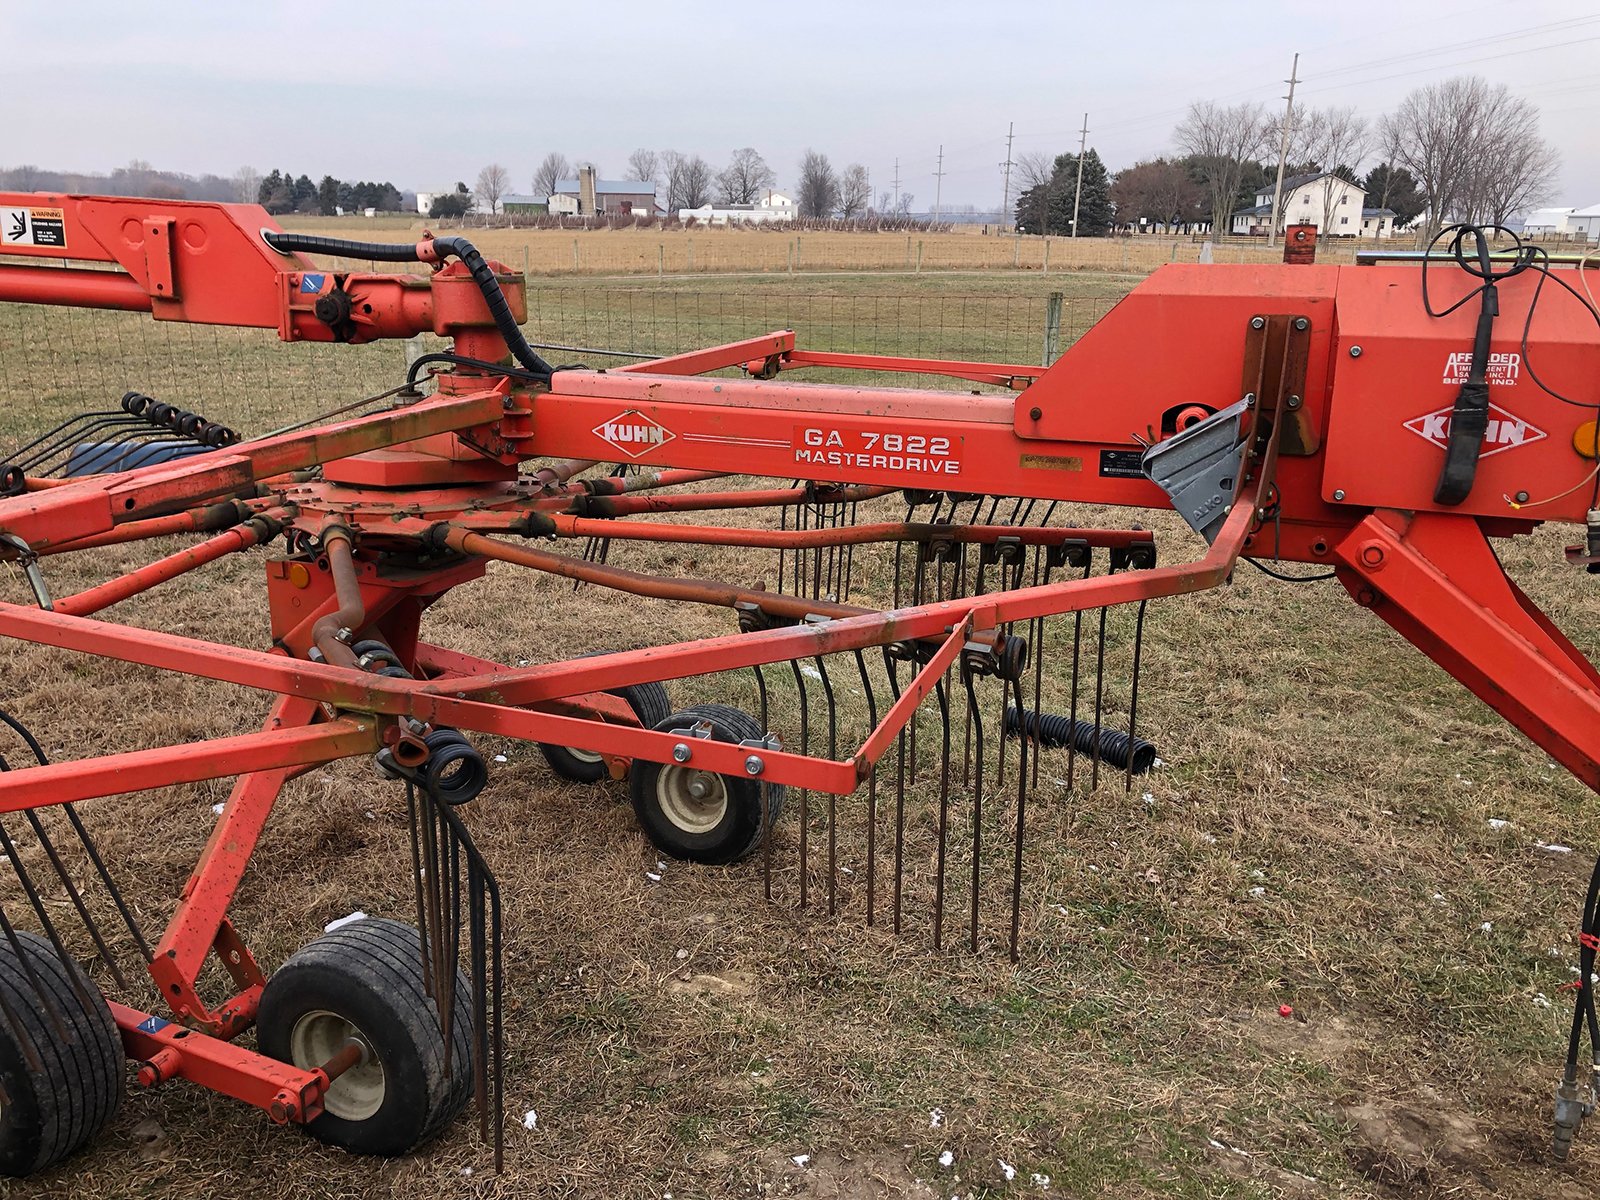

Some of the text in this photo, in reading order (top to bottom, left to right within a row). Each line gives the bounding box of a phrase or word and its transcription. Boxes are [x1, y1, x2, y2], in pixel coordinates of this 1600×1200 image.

[1443, 352, 1520, 378] AFFDER
[1492, 378, 1518, 386] IND.
[604, 423, 664, 444] KUHN
[804, 428, 950, 456] GA 7822
[1422, 414, 1526, 445] KHN
[795, 449, 960, 474] MASTERDRIVE
